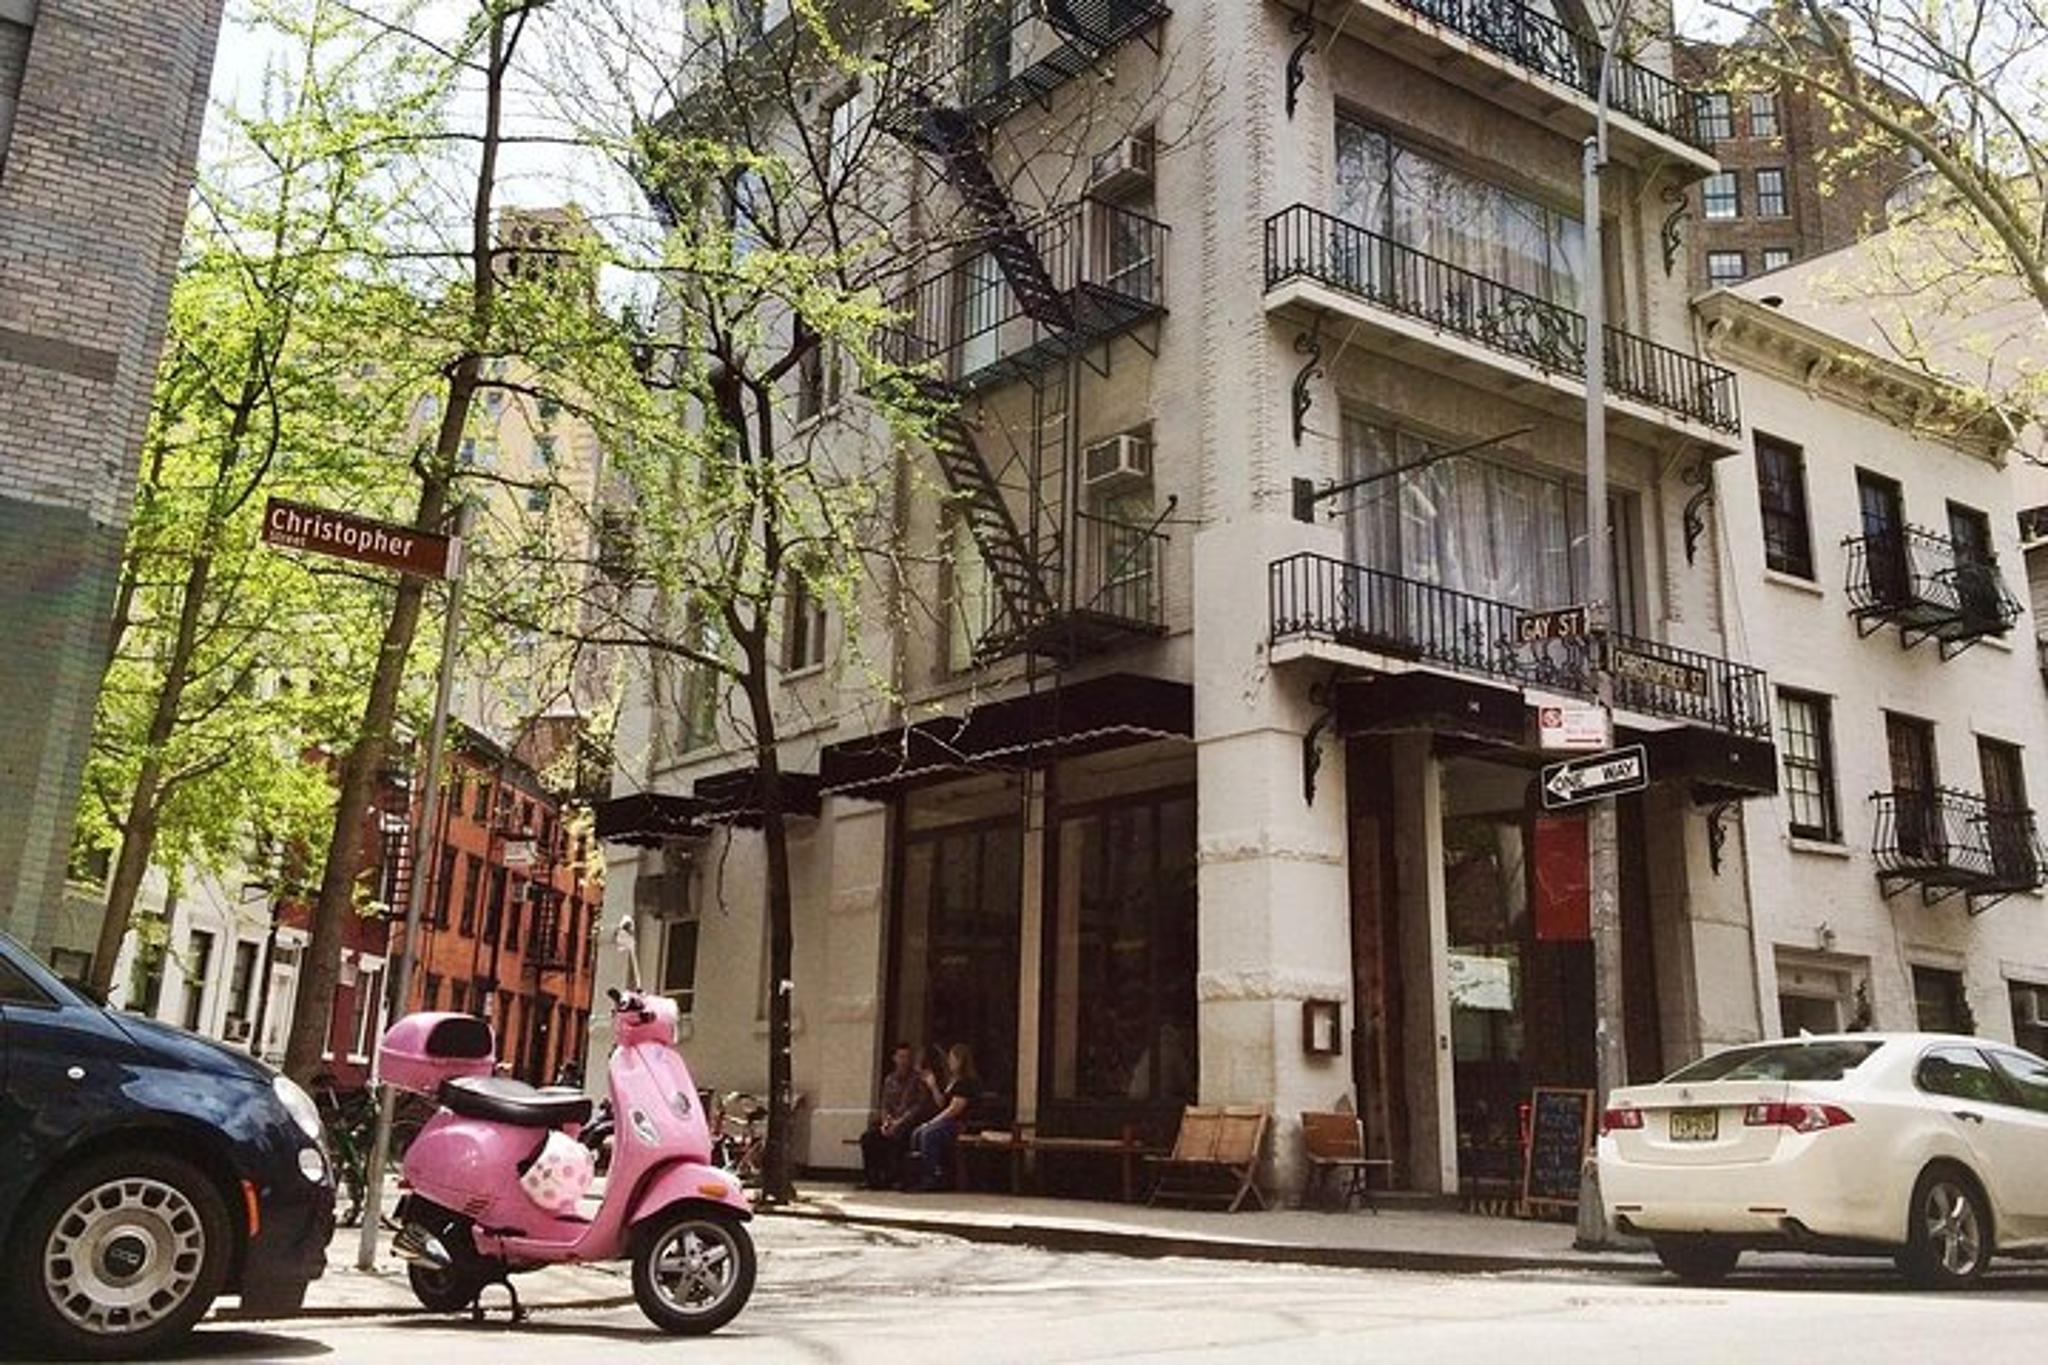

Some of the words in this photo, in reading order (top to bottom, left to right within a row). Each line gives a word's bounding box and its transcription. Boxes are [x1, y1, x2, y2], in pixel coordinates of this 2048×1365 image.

[271, 508, 413, 556] Christopher
[1521, 621, 1551, 641] GAY
[1557, 614, 1579, 635] ST
[1553, 774, 1586, 793] ONE
[1602, 761, 1634, 781] WAY
